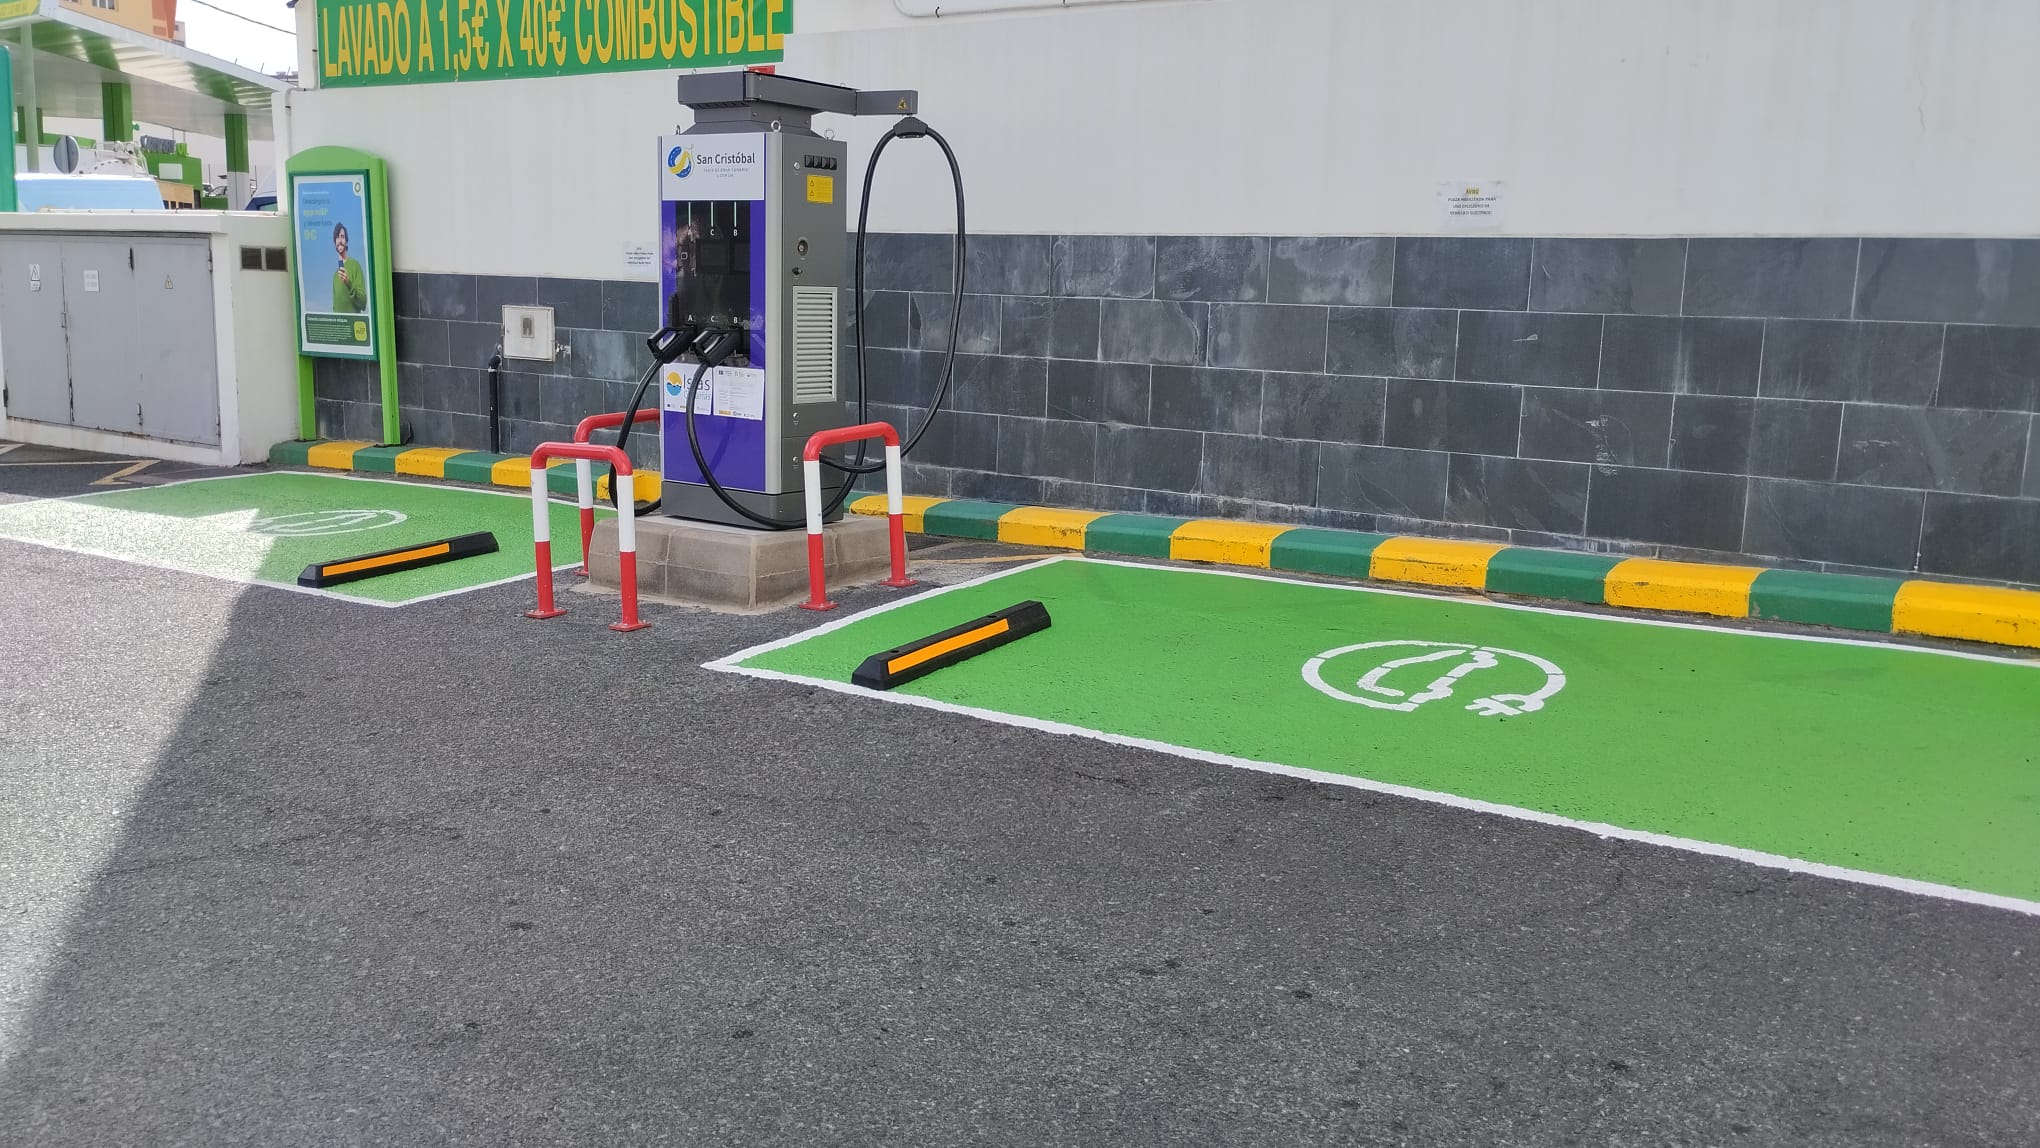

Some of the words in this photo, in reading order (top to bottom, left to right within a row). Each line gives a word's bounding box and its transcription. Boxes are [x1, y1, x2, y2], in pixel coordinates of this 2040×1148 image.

[323, 0, 411, 77] LAVADO
[418, 0, 434, 72] A
[439, 0, 489, 81] 1,5€
[496, 0, 514, 67] X
[520, 0, 567, 67] 40€
[574, 0, 784, 64] COMBUSTIBLE
[696, 154, 713, 165] San
[715, 152, 756, 165] Cristóbal
[683, 373, 711, 391] Isas
